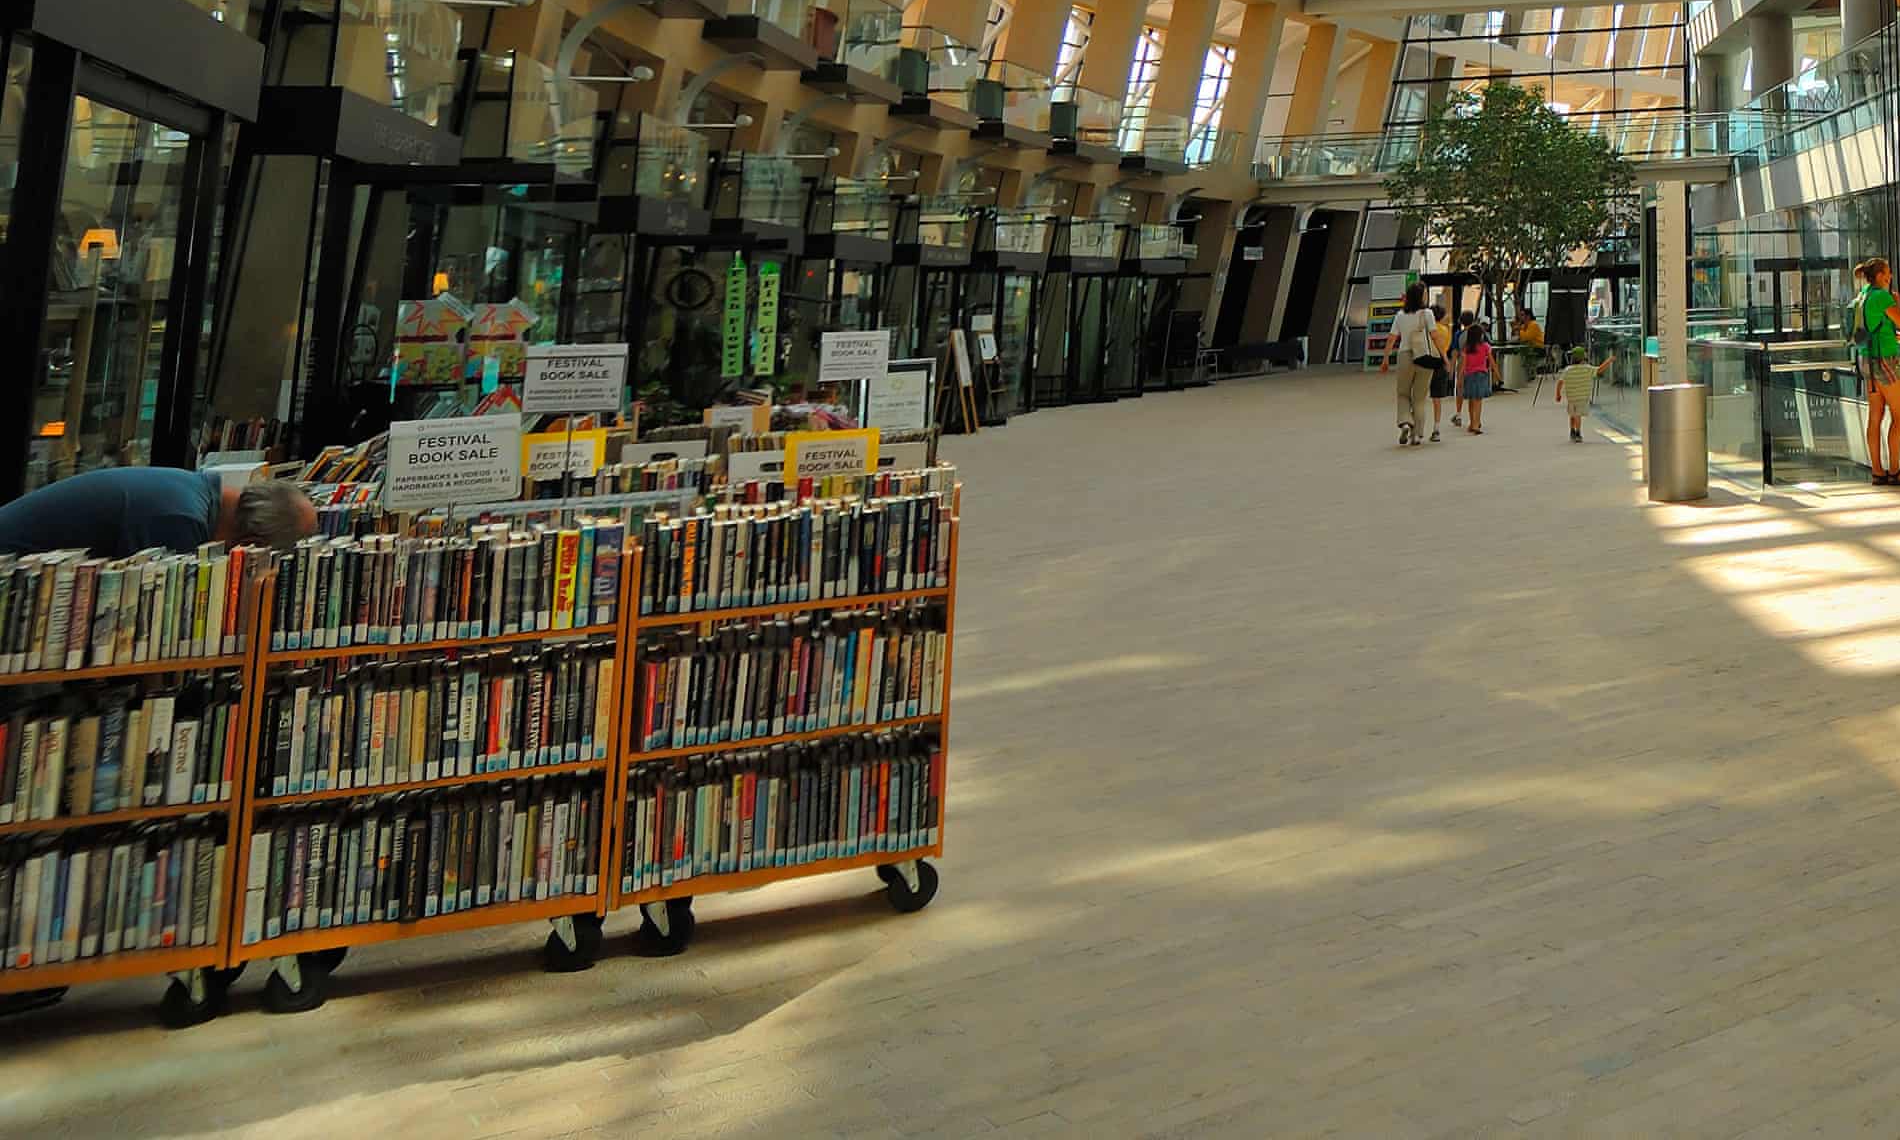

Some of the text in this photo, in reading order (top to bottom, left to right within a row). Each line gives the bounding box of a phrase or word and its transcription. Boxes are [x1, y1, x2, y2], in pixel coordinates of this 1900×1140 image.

[762, 279, 776, 317] Fine
[1657, 281, 1667, 325] CITY
[727, 316, 740, 374] Flowers
[836, 340, 873, 349] FESTIVAL
[857, 349, 877, 357] SALE
[547, 358, 605, 368] FESTIVAL
[540, 370, 609, 380] BOOK SALE
[418, 433, 491, 449] FESTIVAL
[408, 447, 499, 464] BOOK SALE
[805, 449, 857, 460] FESTIVAL
[530, 462, 561, 471] BOOK
[798, 460, 863, 473] BOOK SALE
